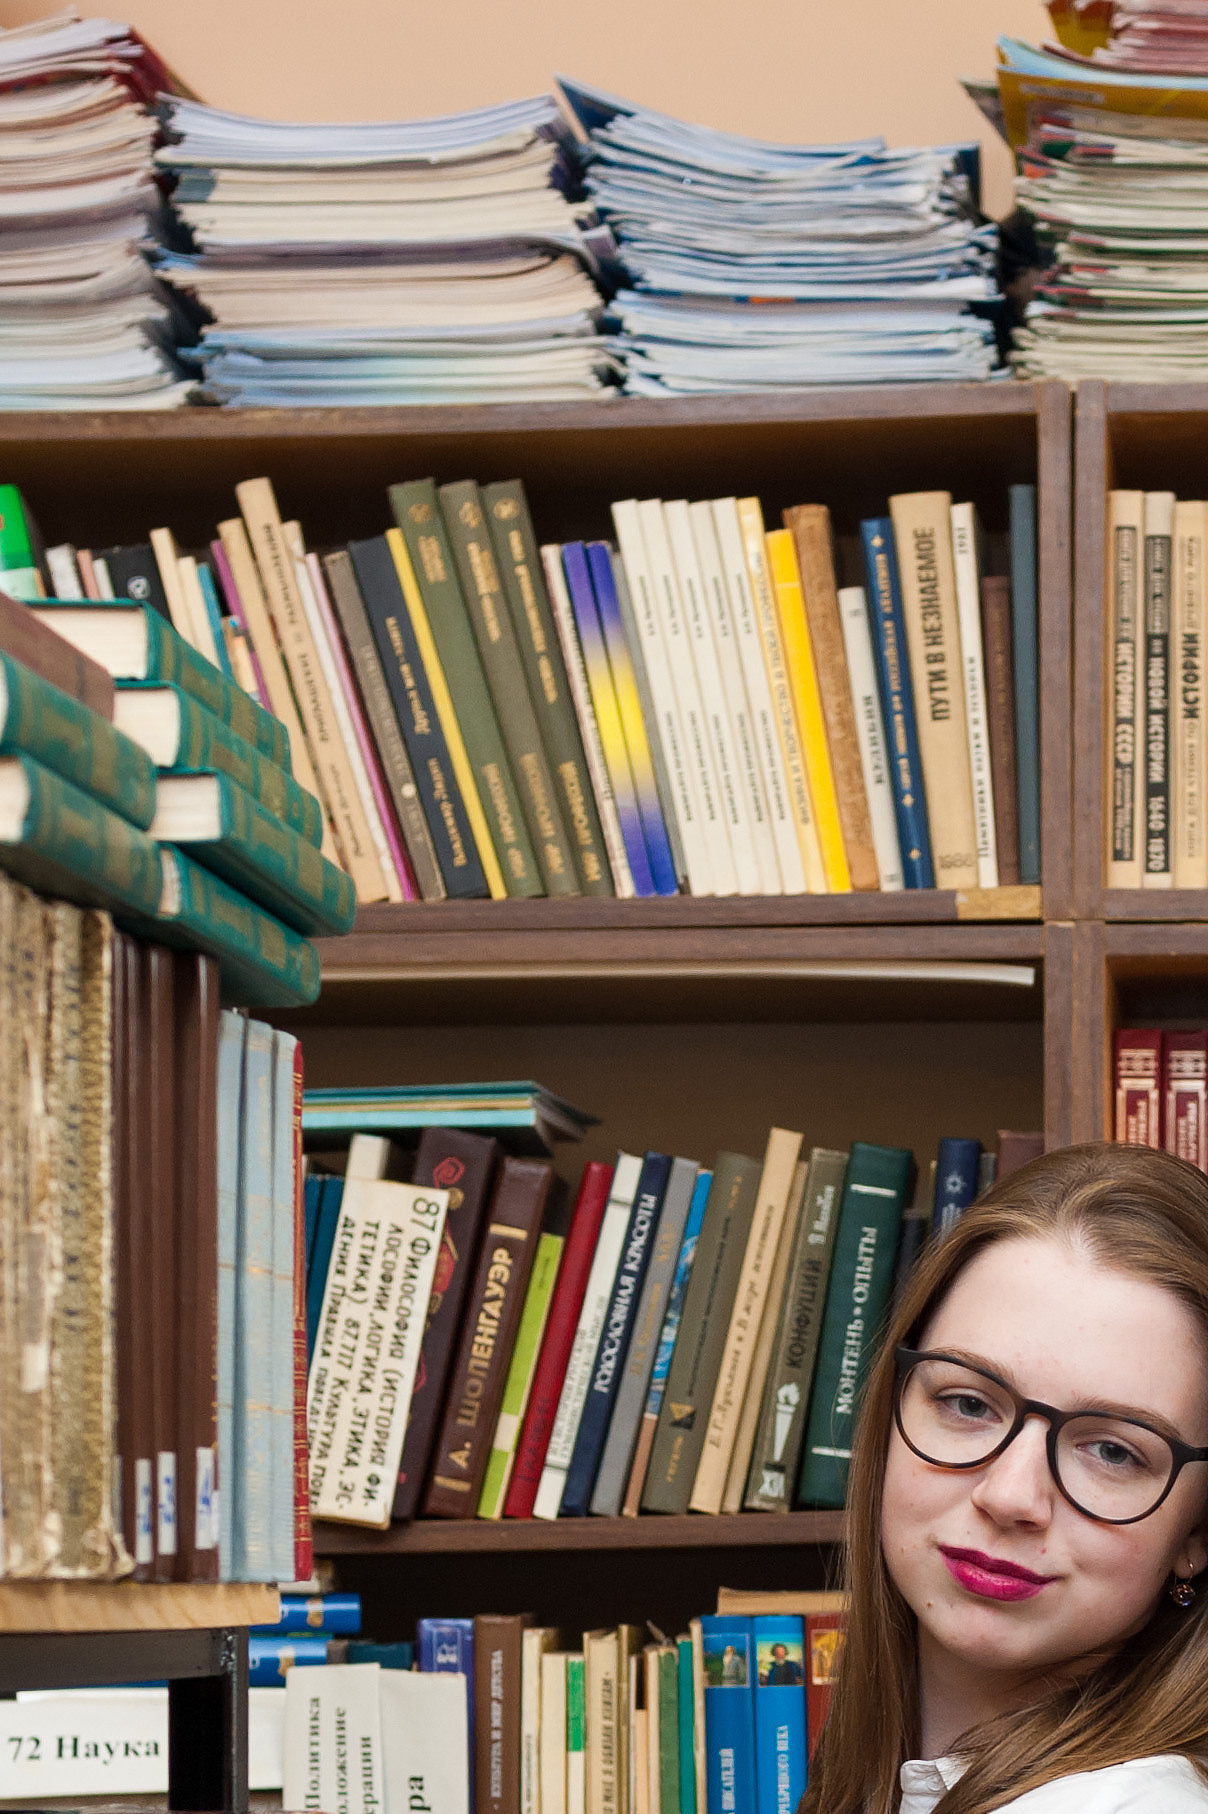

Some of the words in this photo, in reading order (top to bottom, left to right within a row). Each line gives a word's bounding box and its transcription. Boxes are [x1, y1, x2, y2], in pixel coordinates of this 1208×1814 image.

[911, 526, 944, 647] НЕЗНАЕМОЕ
[923, 649, 945, 665] В
[926, 667, 951, 722] ПУТИ
[1114, 641, 1133, 718] ИСТОРИИ
[1147, 657, 1168, 710] НОВОЙ
[1181, 632, 1199, 719] ИСТОРИИ
[1114, 723, 1134, 764] СССР
[1148, 713, 1166, 783] ИСТОРИИ
[408, 1196, 442, 1232] 87
[593, 1274, 636, 1393] РОДОСЛОВНАЯ
[622, 1191, 657, 1273] КРАСОТЫ
[847, 1224, 882, 1305] ОПЫТЫ
[456, 1245, 515, 1430] ШОПЕНГАУЭР
[831, 1316, 869, 1415] МОНТЕНЬ
[447, 1439, 471, 1470] А.
[7, 1736, 42, 1762] 72
[55, 1735, 160, 1765] Наука
[304, 1697, 323, 1810] Политика
[335, 1706, 351, 1812] оложение
